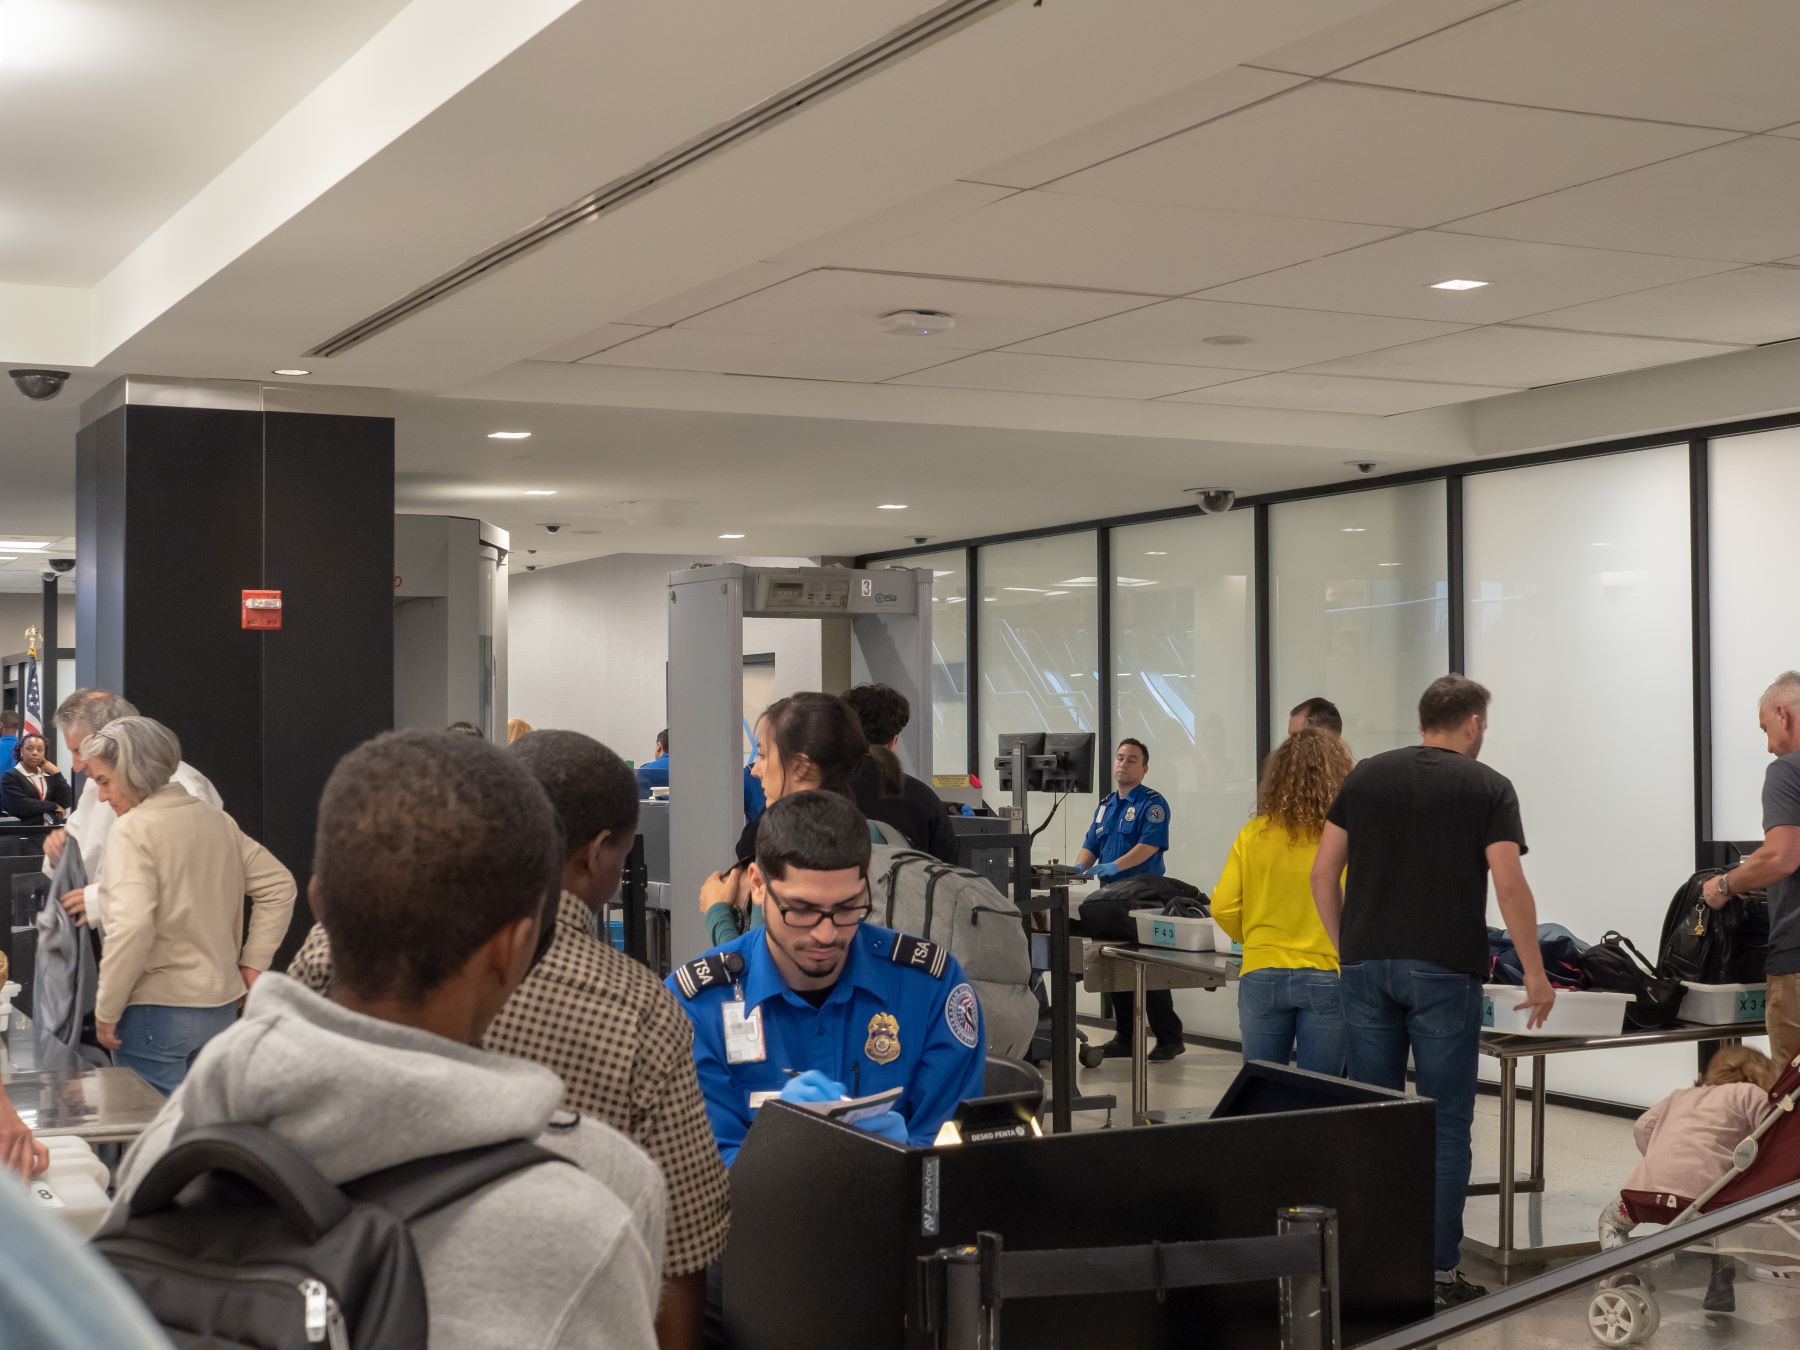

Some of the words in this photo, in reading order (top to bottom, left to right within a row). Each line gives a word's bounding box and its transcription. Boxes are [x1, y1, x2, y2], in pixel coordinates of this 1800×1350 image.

[863, 580, 870, 596] 3
[910, 941, 931, 965] TSA
[693, 958, 714, 985] TSA
[971, 1131, 994, 1142] DESKO
[994, 1128, 1016, 1139] PENTA
